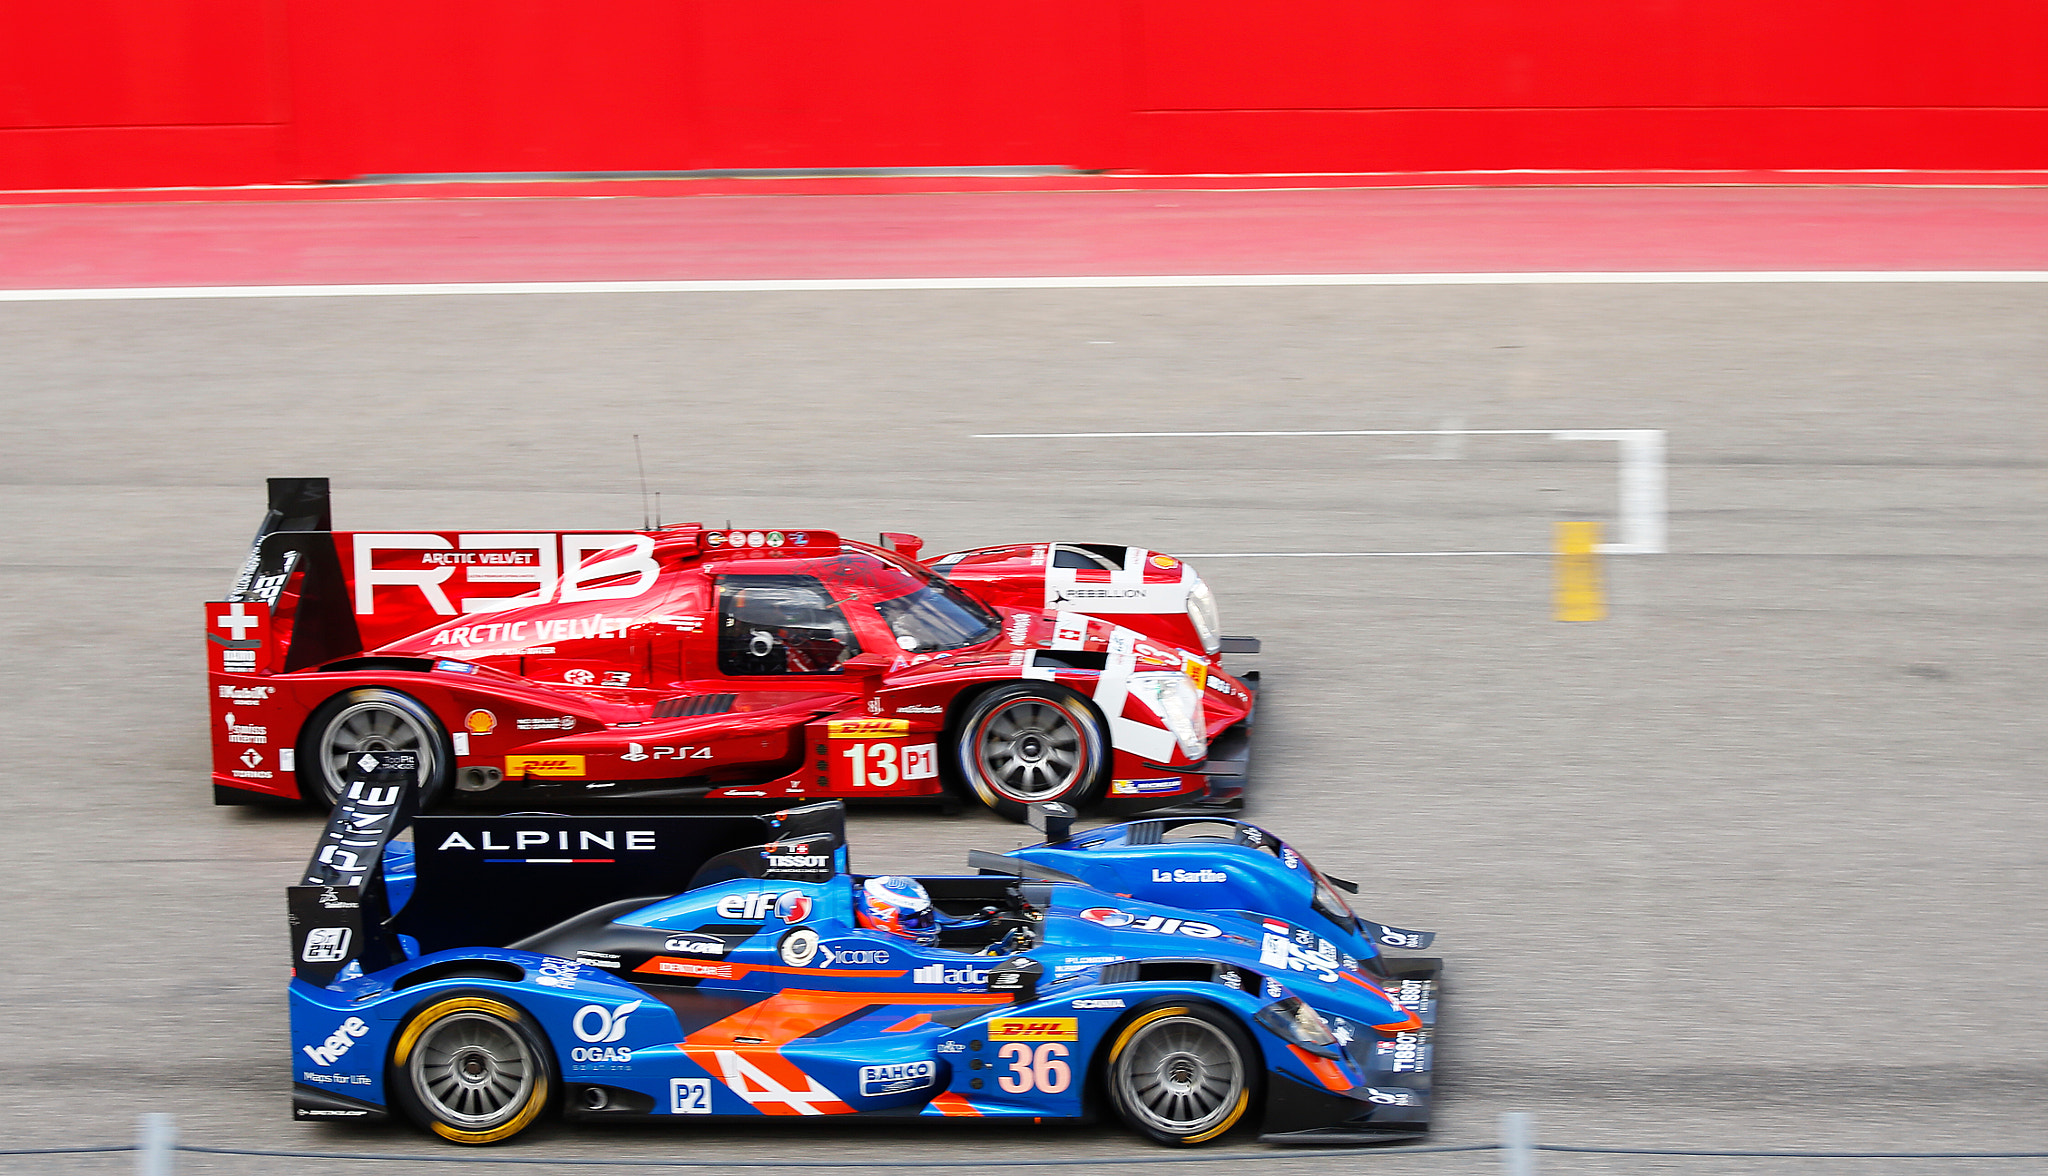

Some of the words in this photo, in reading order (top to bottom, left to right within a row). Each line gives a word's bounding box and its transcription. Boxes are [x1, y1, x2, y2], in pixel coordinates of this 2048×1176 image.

[422, 552, 476, 566] ARCTIC
[479, 551, 533, 565] VELVET
[1066, 589, 1147, 598] REBELLION
[430, 620, 528, 648] ARCTIC
[535, 613, 633, 640] VELVET
[841, 721, 897, 733] DHL
[653, 746, 714, 760] PS4
[522, 760, 569, 771] DHL
[843, 742, 899, 787] 13
[908, 751, 931, 775] P1
[438, 830, 657, 851] ALPINE
[766, 855, 830, 867] TISSOT
[1152, 868, 1173, 883] La
[1173, 868, 1228, 883] Sarthe
[717, 890, 778, 919] elf
[1131, 915, 1223, 939] elf
[835, 945, 890, 964] icore
[1072, 998, 1126, 1010] SCANIA
[1002, 1023, 1063, 1036] DHL
[303, 1016, 370, 1067] here
[571, 1046, 632, 1063] OGAS
[867, 1063, 928, 1081] BAHCO
[998, 1042, 1071, 1094] 36
[303, 1071, 332, 1084] Maps
[332, 1072, 350, 1084] for
[350, 1074, 372, 1086] Life
[678, 1084, 707, 1109] P2
